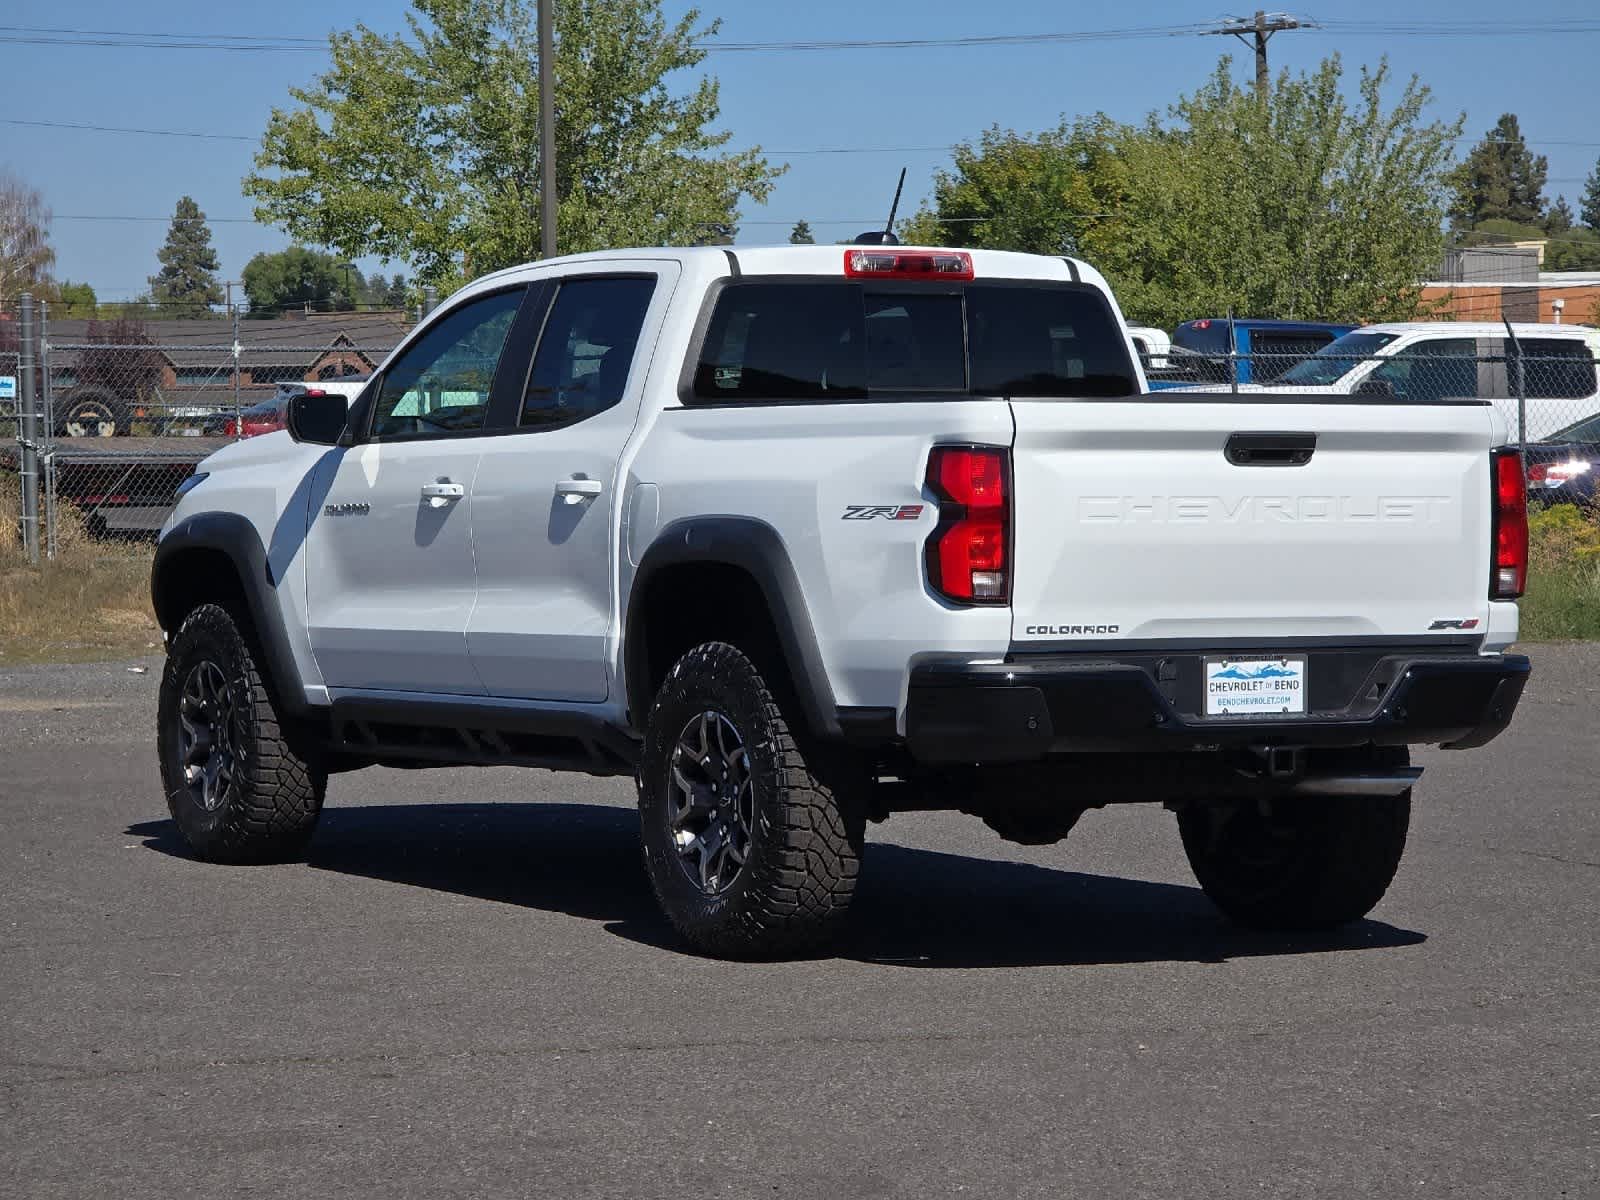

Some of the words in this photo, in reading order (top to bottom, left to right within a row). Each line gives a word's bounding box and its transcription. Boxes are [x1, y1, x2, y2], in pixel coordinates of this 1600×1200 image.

[841, 505, 924, 521] ZR2
[1080, 495, 1451, 523] CHEVROLET
[1026, 625, 1120, 635] COLORADO
[1427, 619, 1479, 631] ZR2
[1209, 680, 1264, 692] CHEVROLET
[1274, 680, 1299, 690] BEND
[1217, 696, 1291, 706] BENDCHEVROLET.COM
